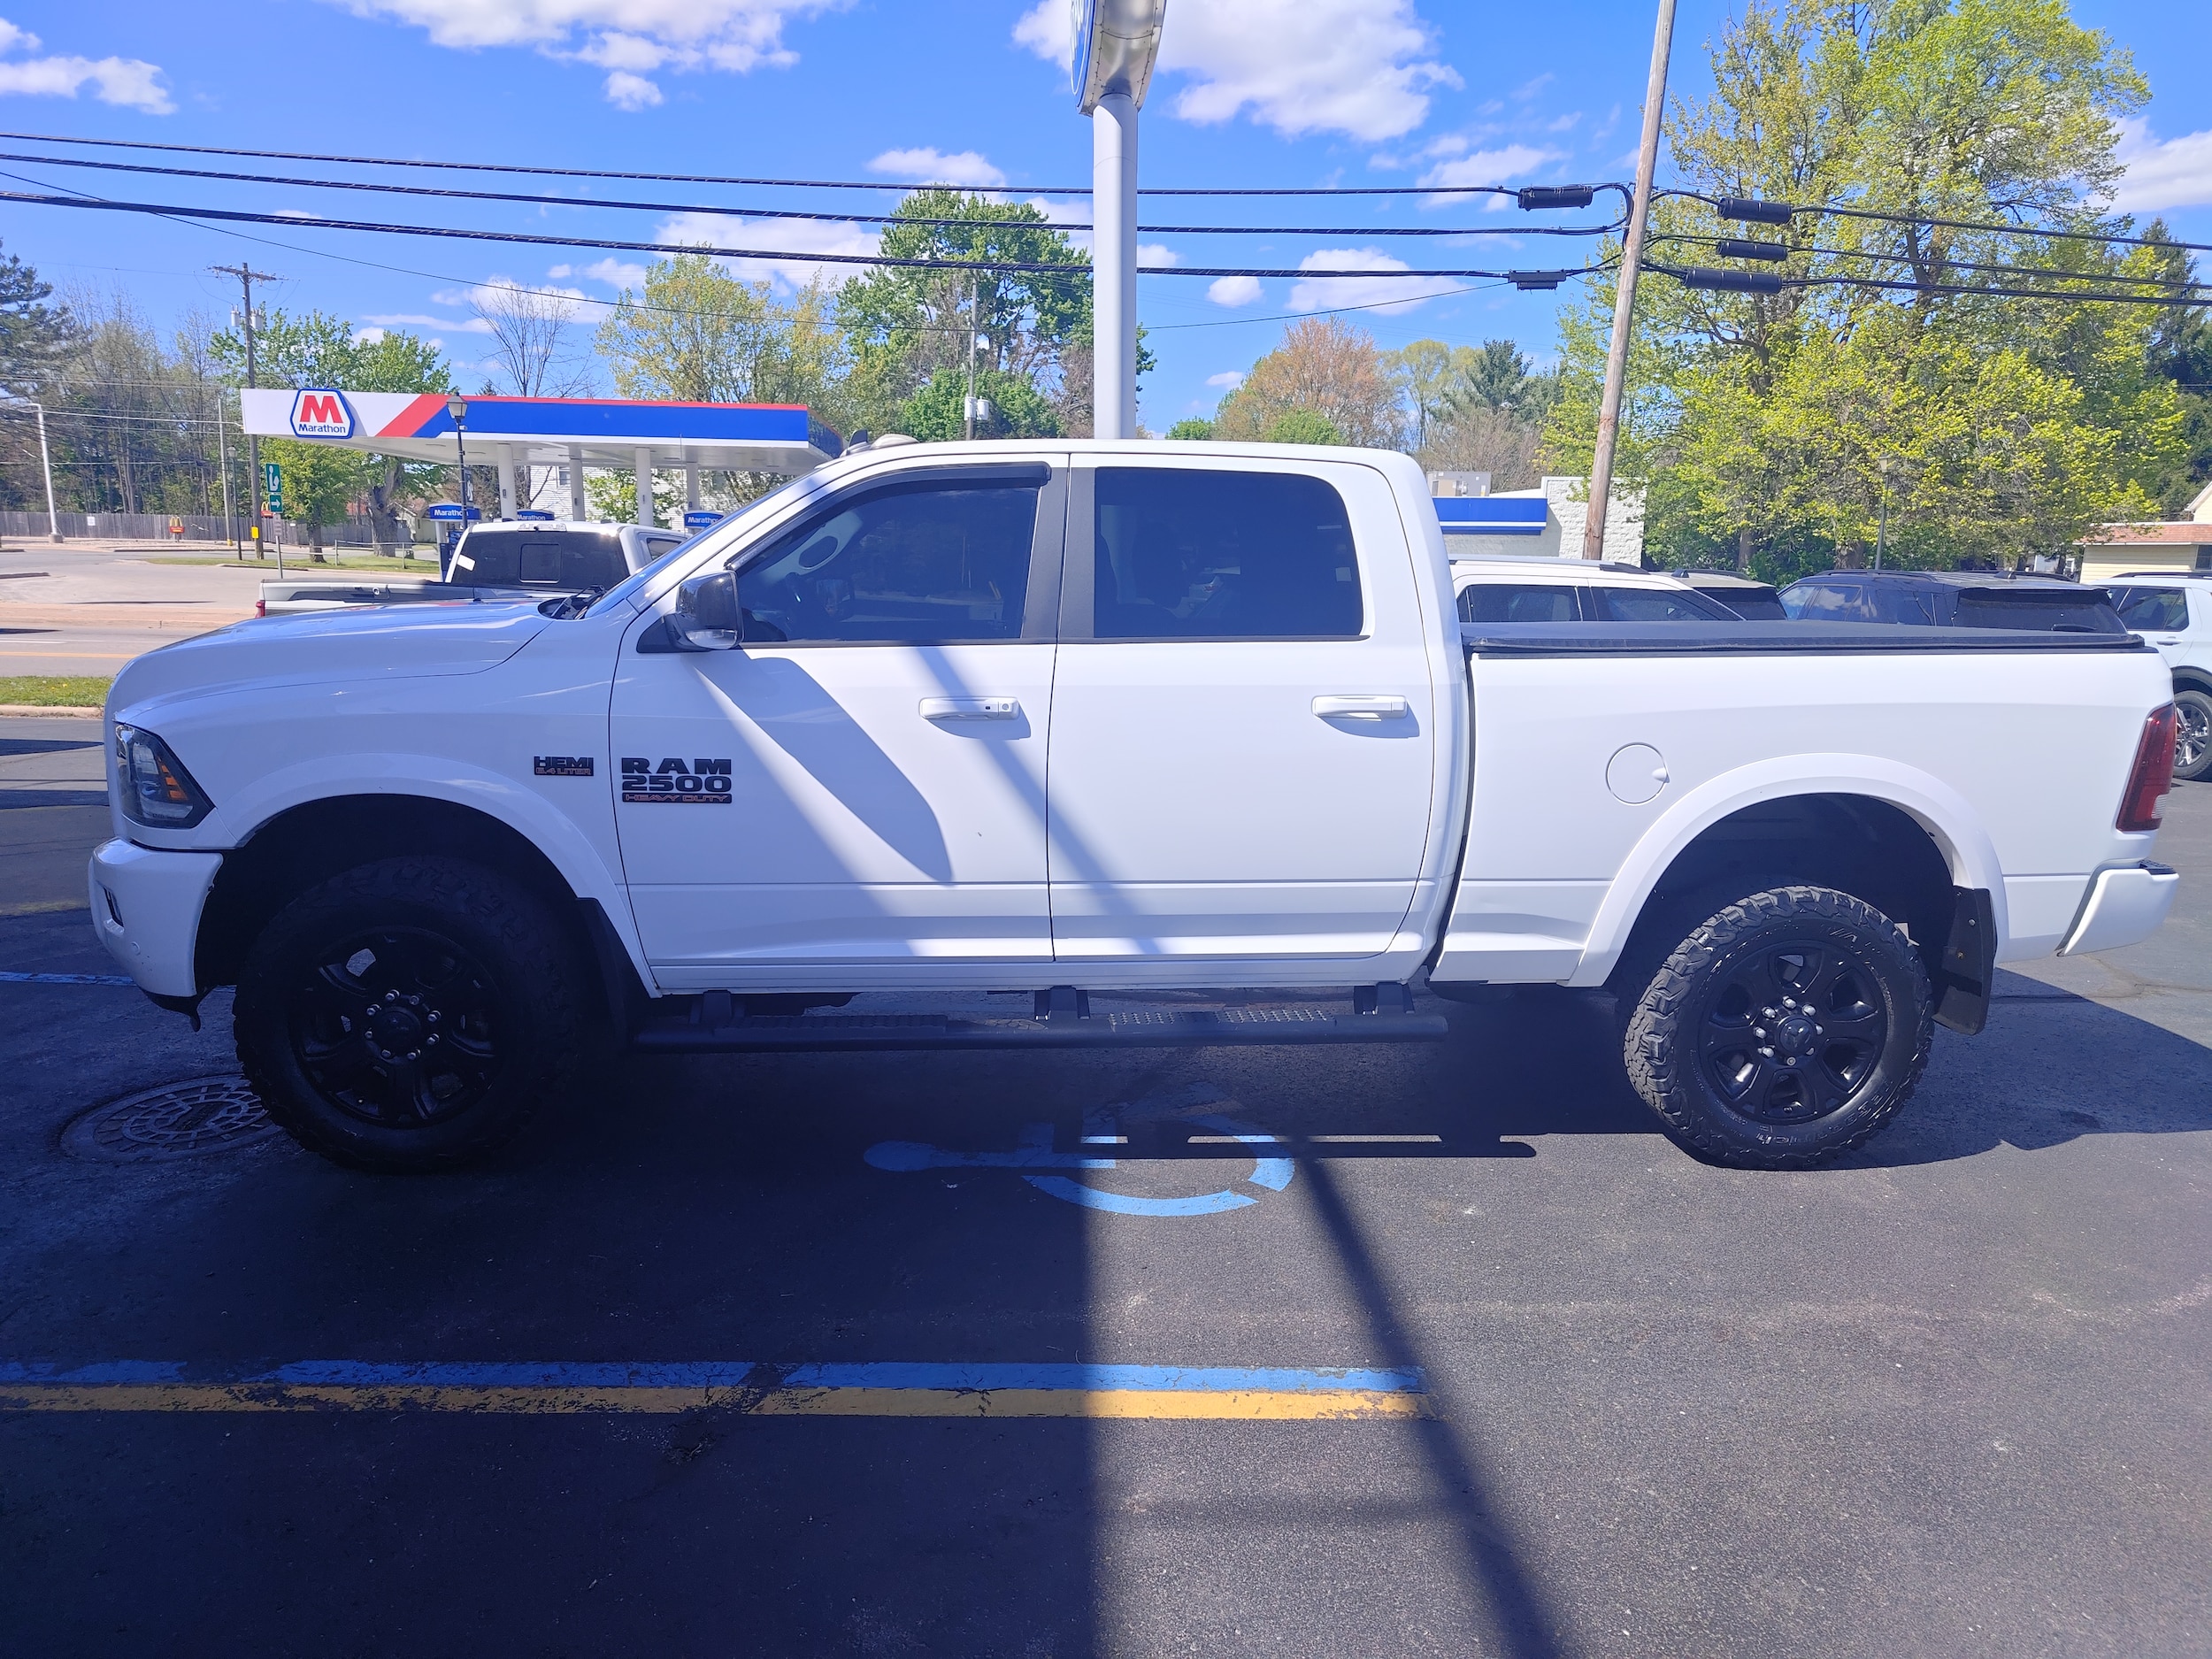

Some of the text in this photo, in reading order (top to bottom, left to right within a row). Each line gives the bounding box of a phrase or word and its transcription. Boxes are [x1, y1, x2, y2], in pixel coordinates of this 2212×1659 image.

[300, 395, 343, 423] M
[298, 423, 346, 434] Marathon
[687, 516, 718, 525] Maratho
[534, 756, 594, 768] HEMI
[621, 757, 732, 775] RAM
[622, 775, 732, 793] 2500
